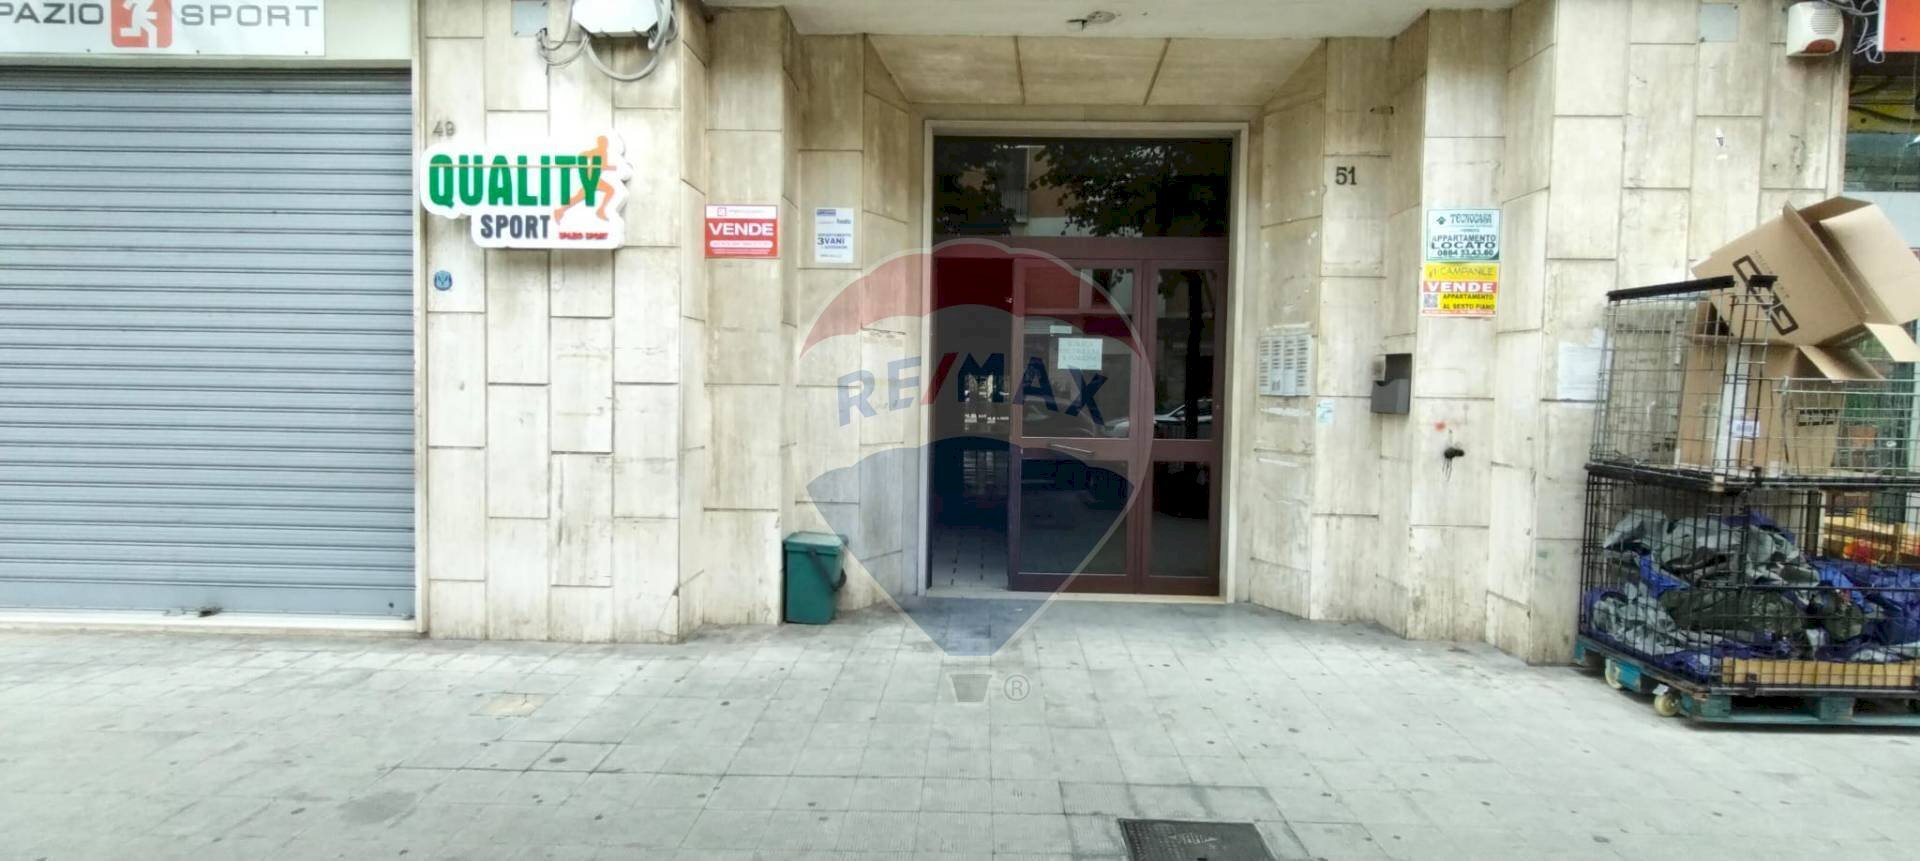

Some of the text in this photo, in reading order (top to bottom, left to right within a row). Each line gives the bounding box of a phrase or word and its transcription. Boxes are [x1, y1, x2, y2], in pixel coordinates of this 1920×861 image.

[180, 4, 318, 27] SPORT
[432, 120, 456, 136] 49
[429, 153, 602, 208] QUALITY
[1335, 166, 1357, 185] 51
[480, 214, 550, 239] SPORT
[708, 222, 774, 236] VENDE
[1431, 241, 1496, 249] LOCATO
[1432, 234, 1496, 242] APPARTAMENTO
[1427, 282, 1494, 292] VENDE
